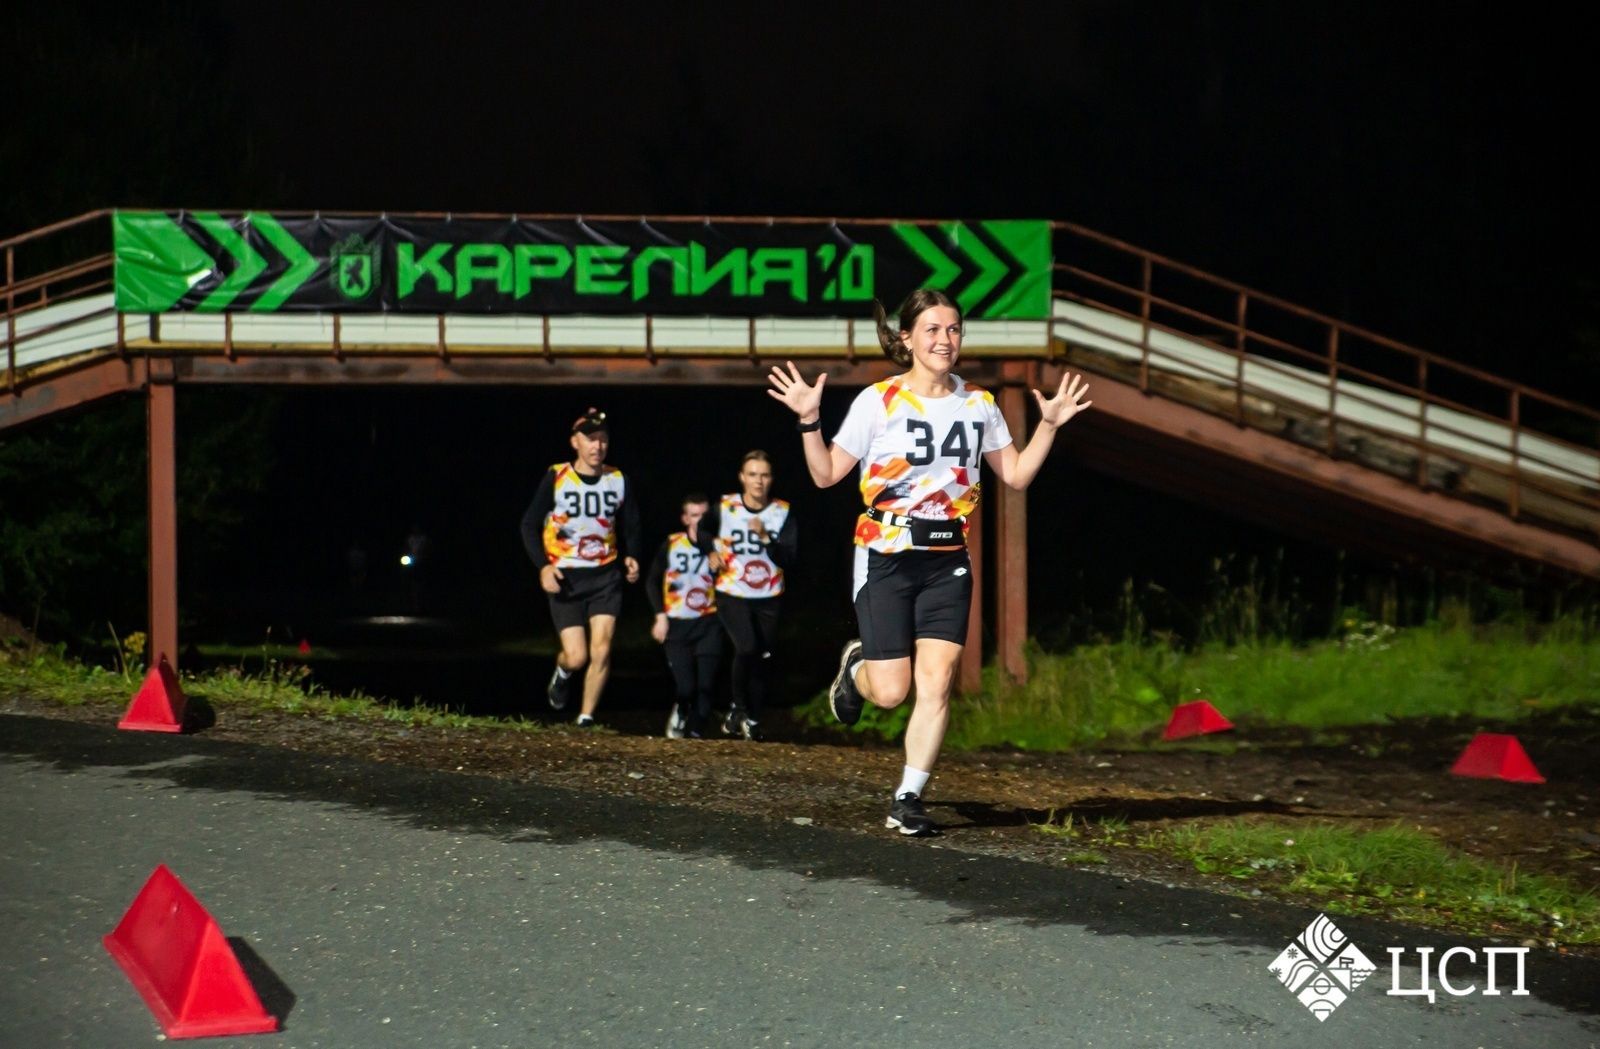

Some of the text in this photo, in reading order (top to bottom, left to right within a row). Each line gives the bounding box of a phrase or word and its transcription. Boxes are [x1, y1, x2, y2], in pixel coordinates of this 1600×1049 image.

[397, 240, 808, 302] КАРЕЛИЯ
[906, 418, 985, 468] 341
[564, 491, 618, 517] 305
